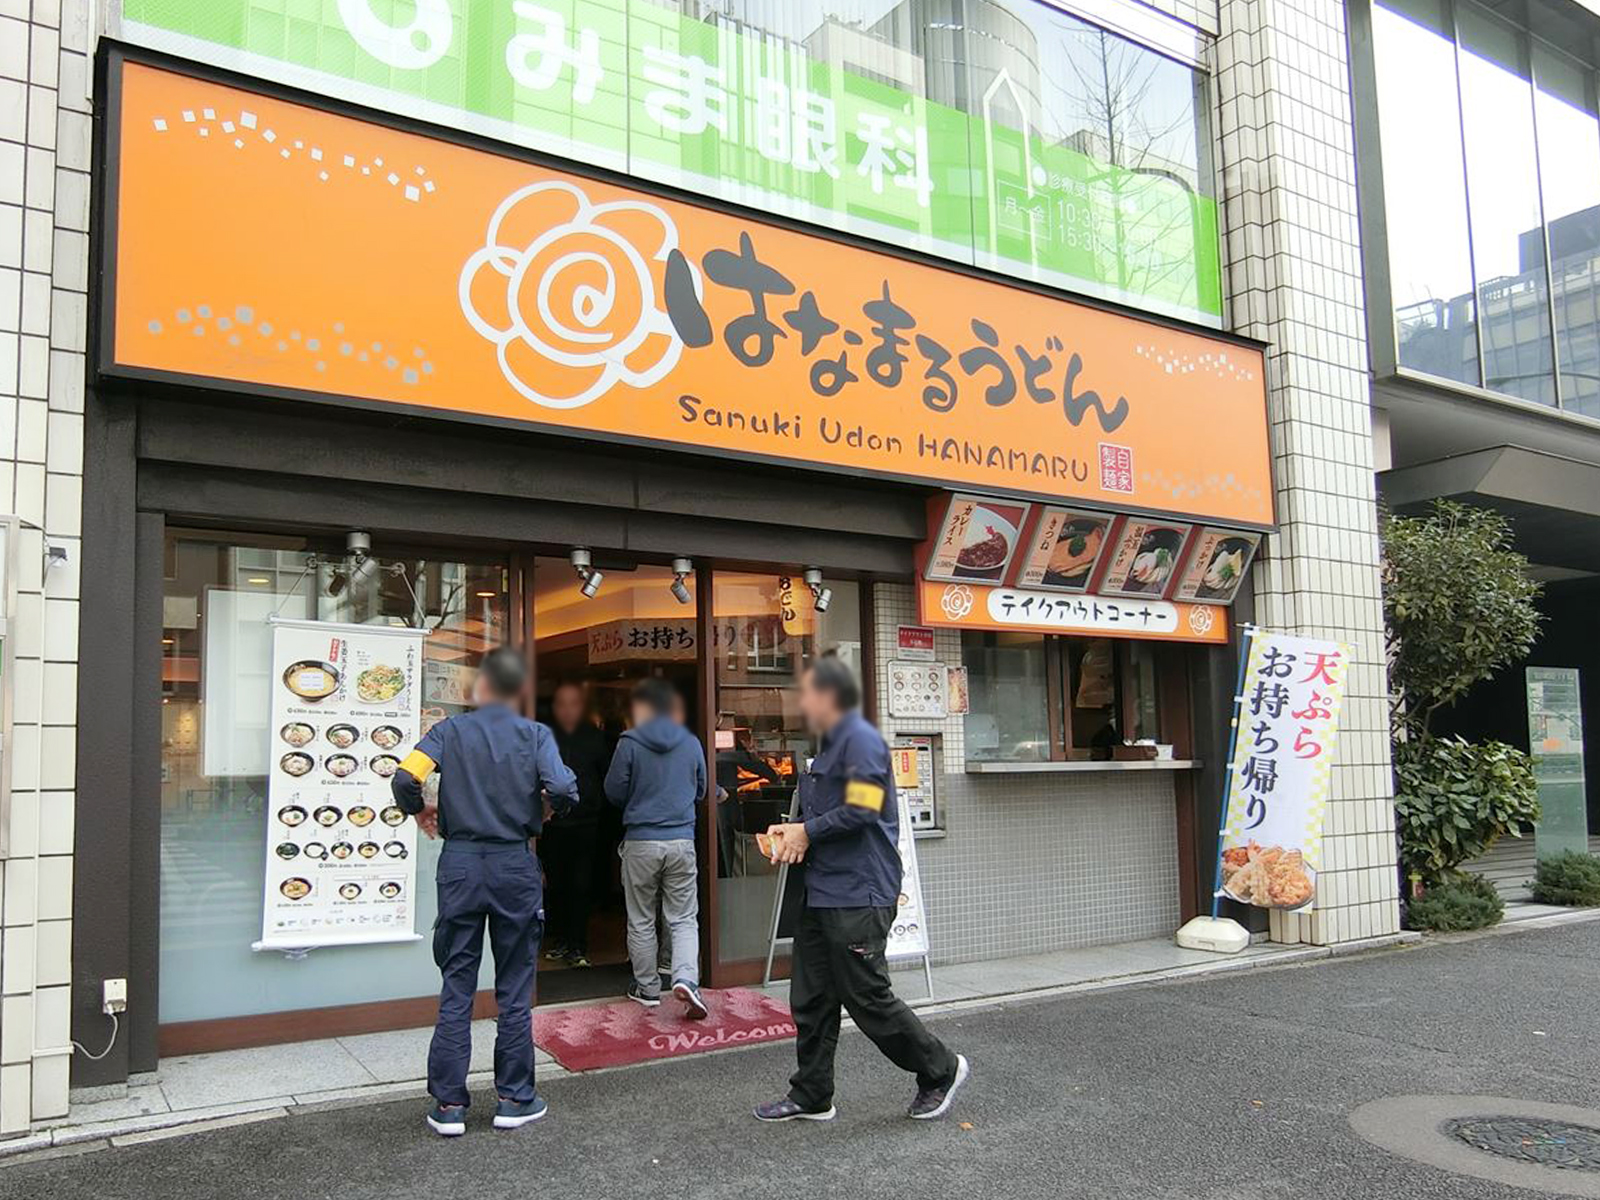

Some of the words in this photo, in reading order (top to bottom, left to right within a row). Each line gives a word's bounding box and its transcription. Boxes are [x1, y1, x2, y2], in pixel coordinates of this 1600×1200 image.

[663, 230, 1129, 434] はなまるうどん
[678, 394, 801, 439] Sanuki
[820, 416, 902, 454] Udon
[918, 432, 1089, 482] HANAMARU
[1040, 517, 1057, 551] きつね
[1001, 594, 1167, 625] テイクアウトコーナー
[1240, 646, 1298, 831] お持ち帰り
[1291, 650, 1341, 760] 天ぷら
[648, 1022, 798, 1052] Welcom
